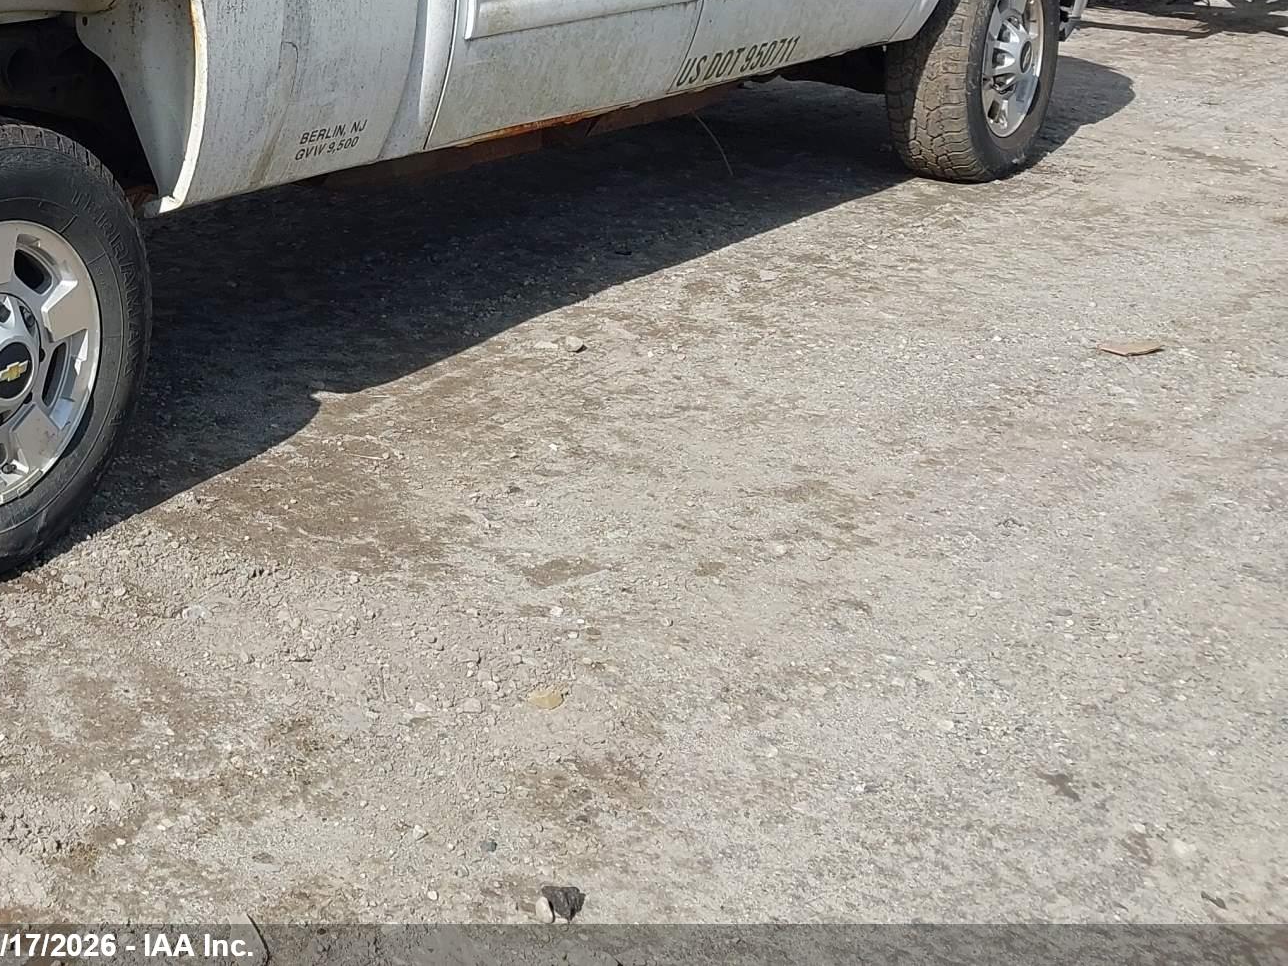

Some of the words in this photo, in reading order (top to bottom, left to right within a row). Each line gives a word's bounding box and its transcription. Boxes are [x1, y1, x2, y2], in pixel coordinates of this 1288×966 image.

[676, 55, 708, 87] US
[703, 47, 746, 81] DOT
[740, 35, 801, 73] 950711
[299, 124, 346, 145] BERLIN,
[350, 119, 368, 134] NJ
